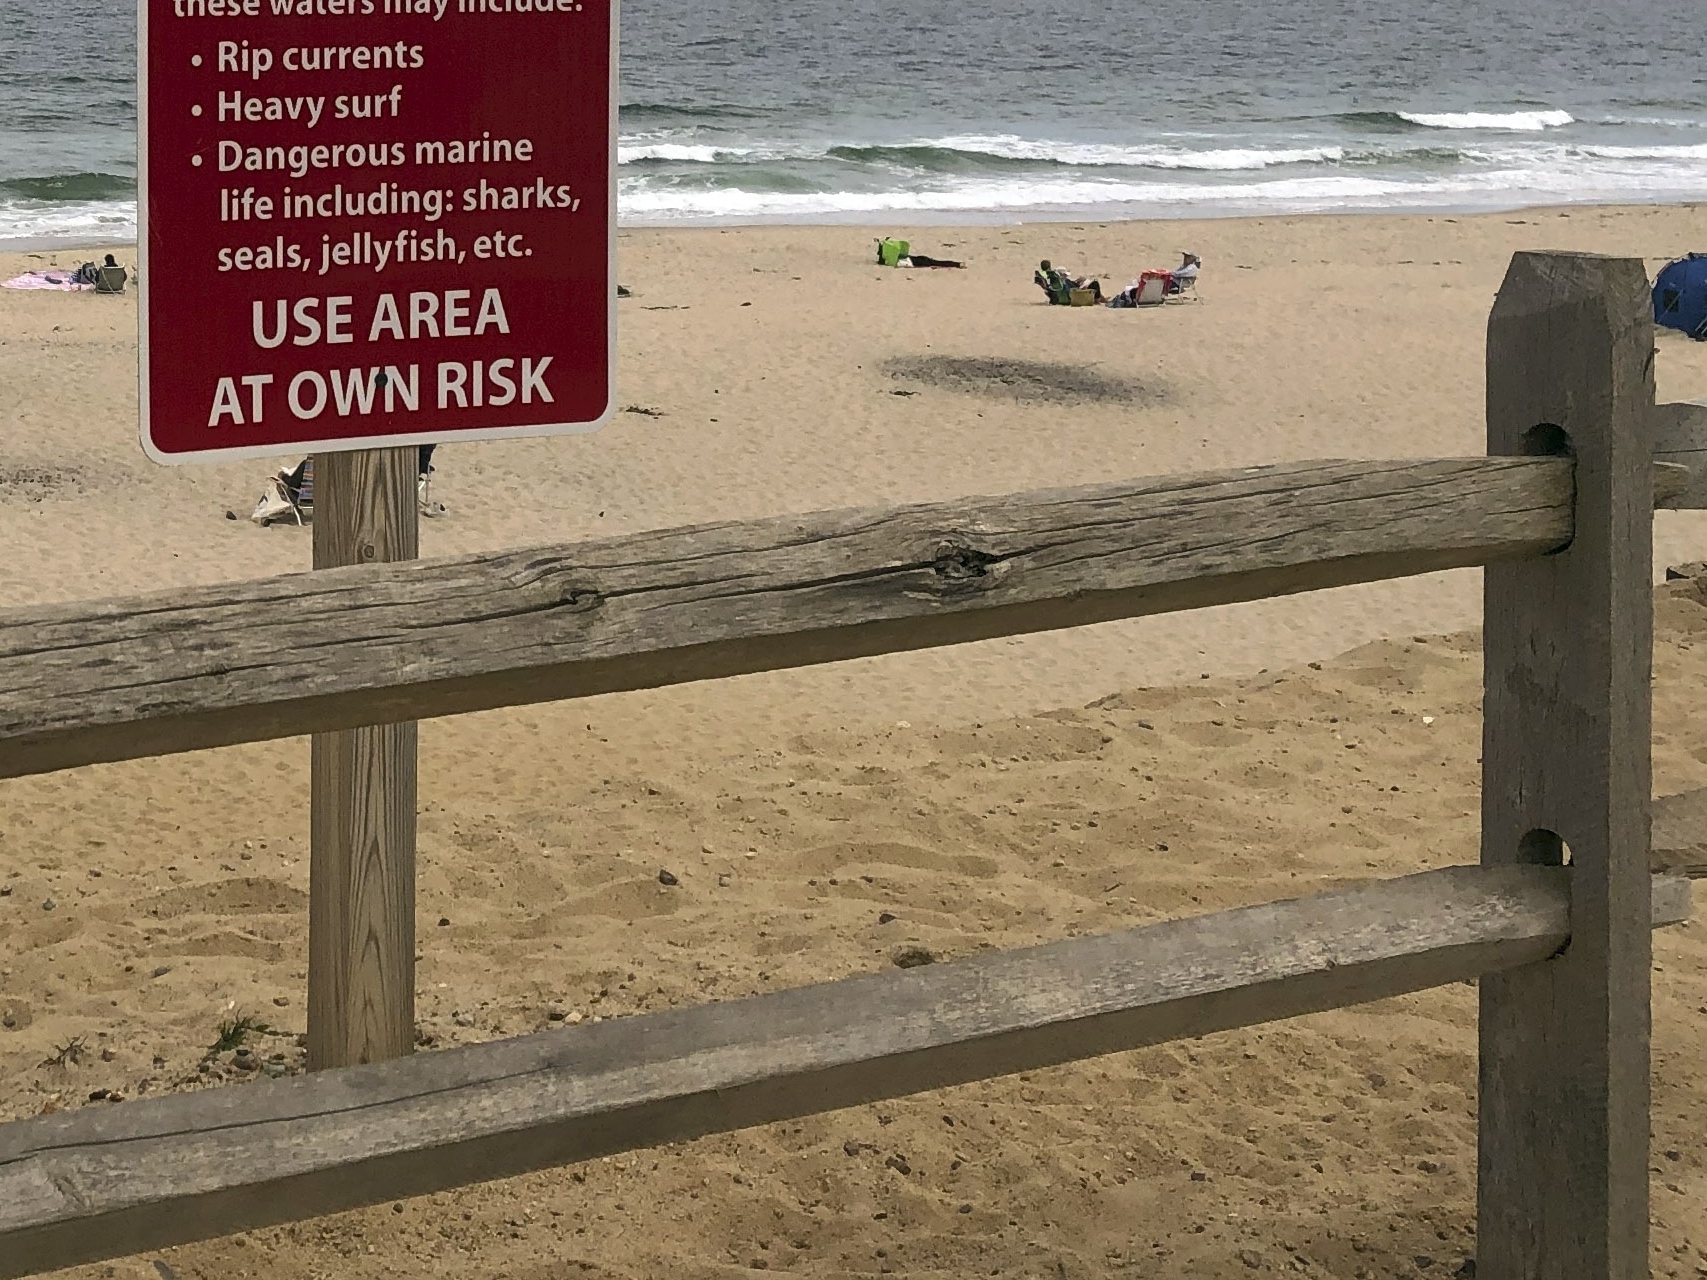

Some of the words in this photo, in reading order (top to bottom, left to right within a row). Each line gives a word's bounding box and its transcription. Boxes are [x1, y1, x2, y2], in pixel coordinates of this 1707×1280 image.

[218, 39, 273, 80] Rip
[282, 40, 424, 70] currents
[218, 90, 325, 128] Heavy
[335, 84, 402, 118] surf
[218, 140, 405, 178] Dangerous
[415, 131, 533, 164] marine
[221, 187, 273, 221] life
[284, 182, 453, 221] including:
[463, 176, 580, 212] sharks,
[217, 235, 310, 272] seals,
[318, 228, 466, 275] jellyfish,
[473, 230, 532, 258] etc.
[252, 295, 353, 348] USE
[368, 287, 510, 341] AREA
[207, 373, 273, 427] AT
[287, 364, 419, 419] OWN
[437, 356, 554, 409] RISK
